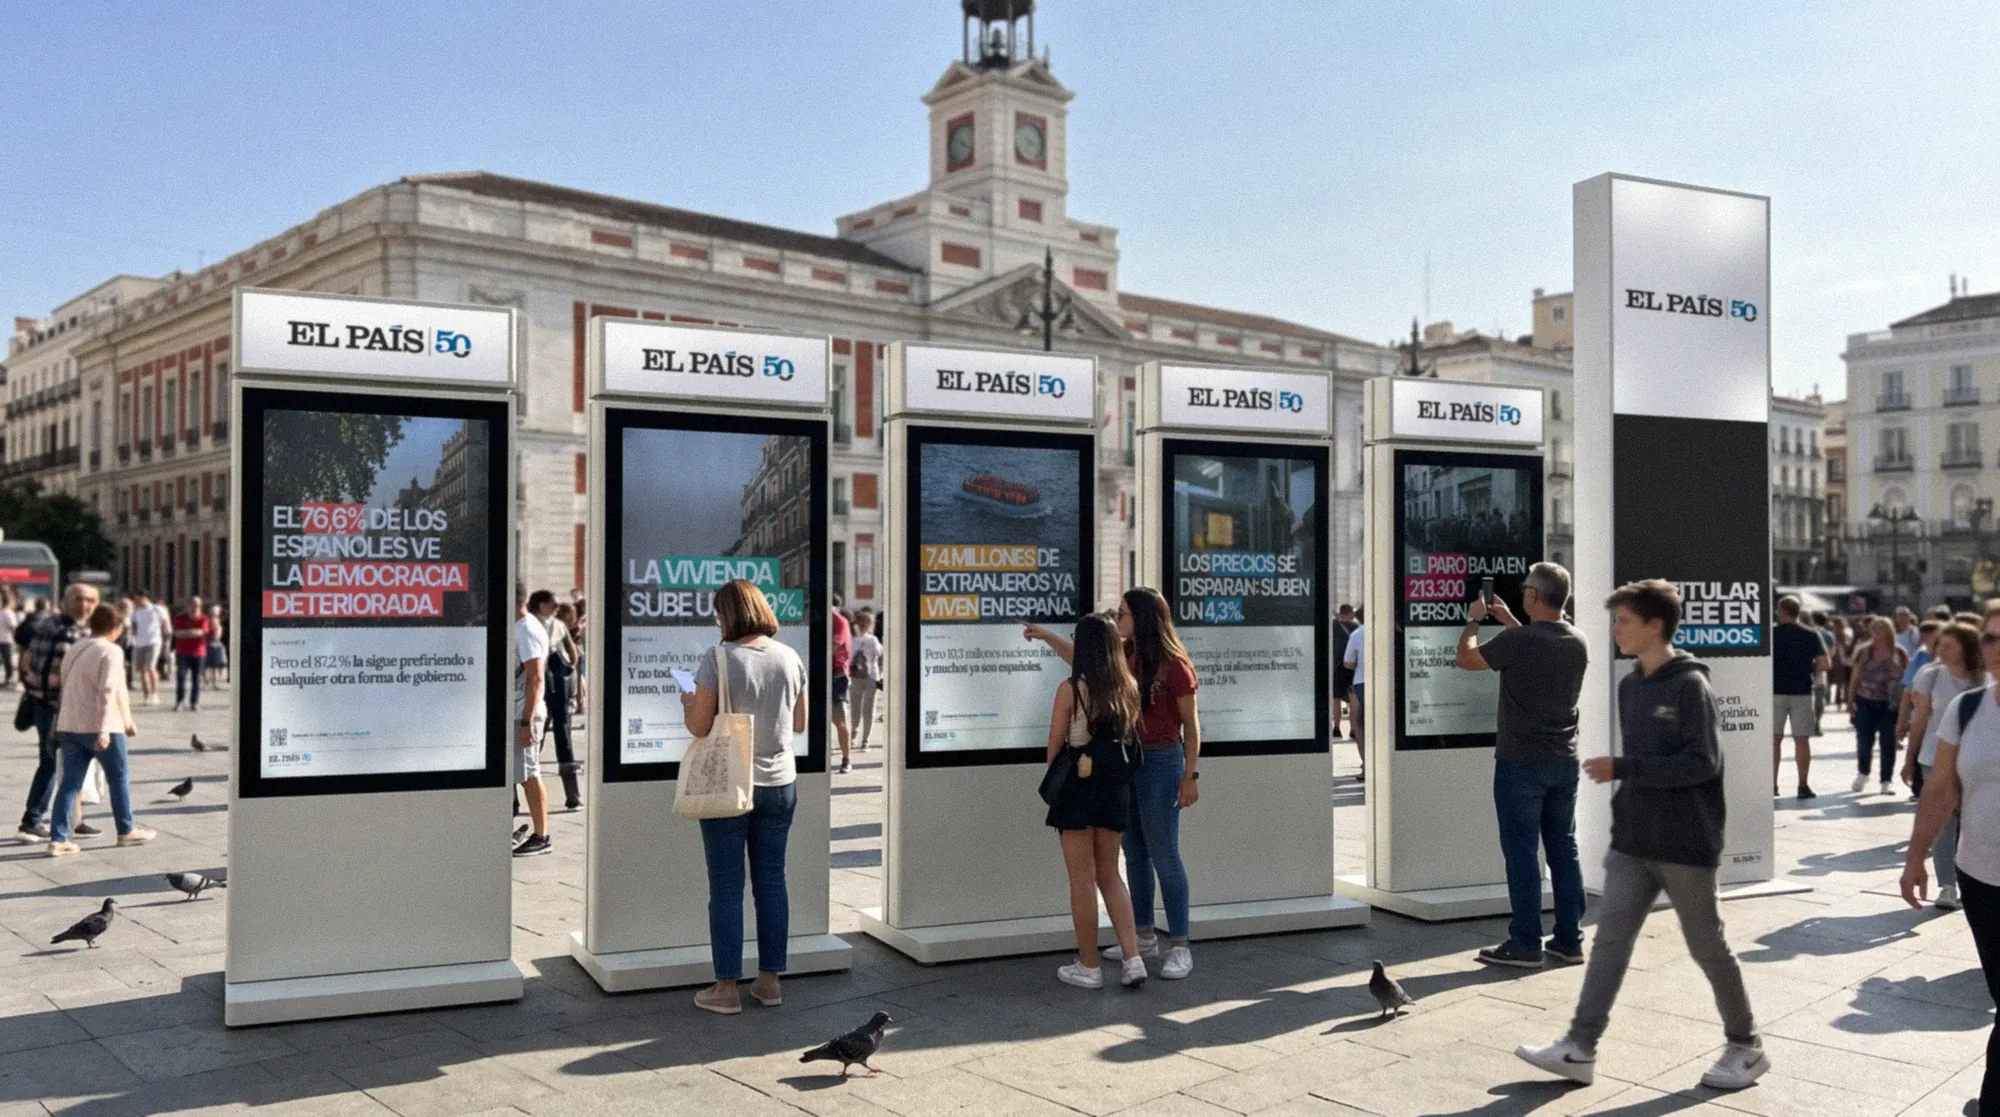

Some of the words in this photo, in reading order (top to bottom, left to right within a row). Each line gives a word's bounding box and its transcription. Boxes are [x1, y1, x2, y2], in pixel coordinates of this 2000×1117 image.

[1625, 289, 1662, 311] EL
[1666, 293, 1723, 317] PAÍS
[1730, 299, 1757, 322] 50
[287, 320, 339, 348] EL
[345, 324, 424, 353] PAÍS
[435, 330, 472, 358] 50
[642, 348, 684, 373] EL
[689, 351, 754, 377] PAÍS
[763, 355, 795, 381] 50
[936, 369, 971, 391] EL
[975, 370, 1031, 396] PAÍS
[1038, 374, 1066, 398] 50
[1188, 387, 1220, 408] EL
[1222, 387, 1273, 410] PAÍS
[1279, 391, 1303, 413] 50
[1417, 400, 1446, 420] EL
[1449, 401, 1494, 423] PAÍS
[1500, 404, 1521, 426] 50
[273, 505, 301, 528] EL
[299, 507, 366, 534] 76,6%
[369, 508, 399, 530] DE
[403, 509, 448, 531] LOS
[273, 530, 409, 558] ESPAÑOLES
[410, 537, 441, 559] VE
[926, 547, 949, 570] 7,4
[951, 548, 1036, 567] MILLONES
[1038, 548, 1060, 567] DE
[1180, 553, 1210, 573] LOS
[1211, 553, 1276, 573] PRECIOS
[1277, 554, 1296, 573] SE
[1410, 556, 1426, 573] EL
[1428, 556, 1467, 574] PARO
[1468, 556, 1506, 574] BAJA
[1507, 556, 1526, 574] EN
[272, 563, 304, 586] LA
[307, 564, 462, 587] DEMOCRACIA
[629, 559, 662, 584] LA
[664, 559, 775, 585] VIVIENDA
[926, 572, 1050, 592] EXTRANJEROS
[1050, 573, 1075, 592] YA
[1180, 577, 1259, 596] DISPARAN:
[1261, 577, 1310, 596] SUBEN
[1409, 579, 1465, 598] 213.300
[272, 592, 439, 615] DETERIORADA.
[629, 591, 694, 617] SUBE
[696, 592, 716, 617] U
[925, 596, 979, 617] VIVEN
[981, 597, 1004, 616] EN
[1006, 591, 1076, 616] ESPAÑA.
[1180, 601, 1204, 621] UN
[1204, 600, 1245, 624] 4,3%.
[1724, 601, 1760, 625] EN
[1672, 628, 1758, 645] GUNDOS.
[270, 655, 299, 669] Pero
[301, 655, 312, 668] el
[338, 656, 351, 668] %
[353, 655, 364, 667] la
[366, 656, 397, 670] sigue
[399, 654, 466, 670] prefiriendo
[467, 656, 474, 666] a
[628, 652, 642, 663] En
[643, 654, 657, 663] un
[659, 651, 681, 665] año,
[684, 653, 696, 662] no
[925, 648, 946, 660] Pero
[965, 647, 1001, 659] millones
[1002, 647, 1039, 658] nacieron
[270, 672, 328, 688] cualquier
[330, 672, 356, 684] otra
[357, 671, 394, 684] forma
[396, 670, 411, 683] de
[412, 670, 467, 687] gobierno.
[627, 670, 637, 679] Y
[638, 670, 652, 679] no
[653, 668, 672, 679] tod
[925, 664, 931, 676] y
[932, 662, 968, 673] muchos
[969, 663, 980, 675] ya
[981, 663, 997, 672] son
[998, 661, 1042, 674] españoles.
[628, 685, 660, 695] mano,
[663, 684, 677, 693] un
[1726, 695, 1741, 704] en
[1739, 722, 1754, 731] un
